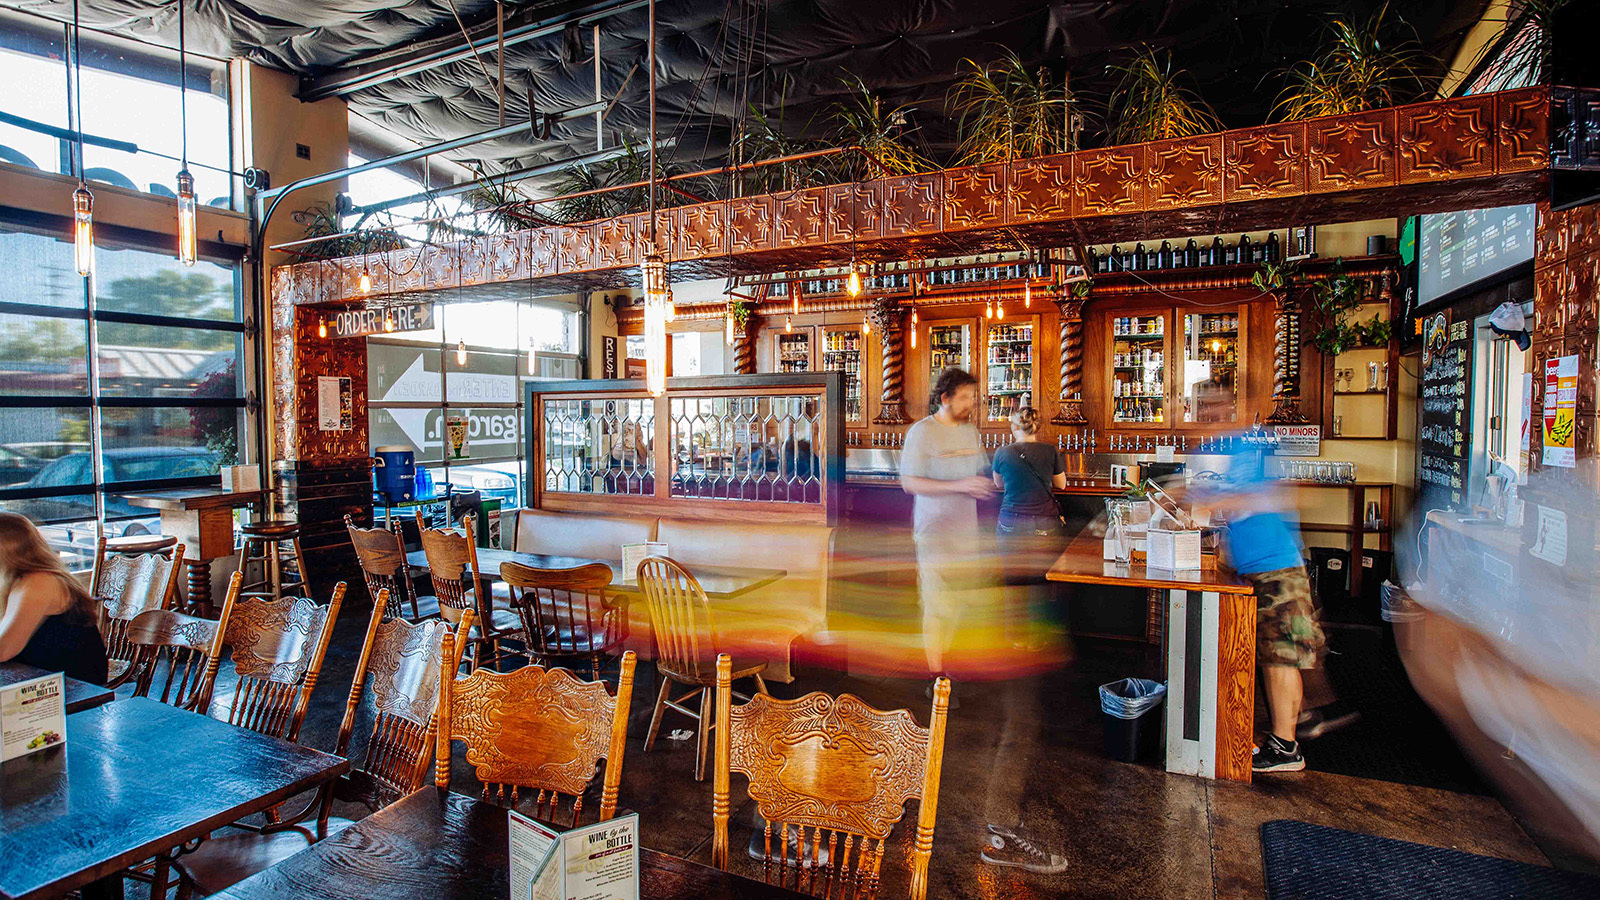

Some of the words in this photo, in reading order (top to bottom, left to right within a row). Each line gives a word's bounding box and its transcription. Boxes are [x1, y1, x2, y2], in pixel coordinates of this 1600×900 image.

[336, 309, 377, 335] ORDER
[1276, 427, 1288, 436] NO
[1289, 427, 1318, 436] MINORS
[21, 685, 37, 694] WINE
[37, 686, 58, 697] BOTTLE
[589, 831, 608, 844] WINE
[607, 834, 632, 849] BOTTLE
